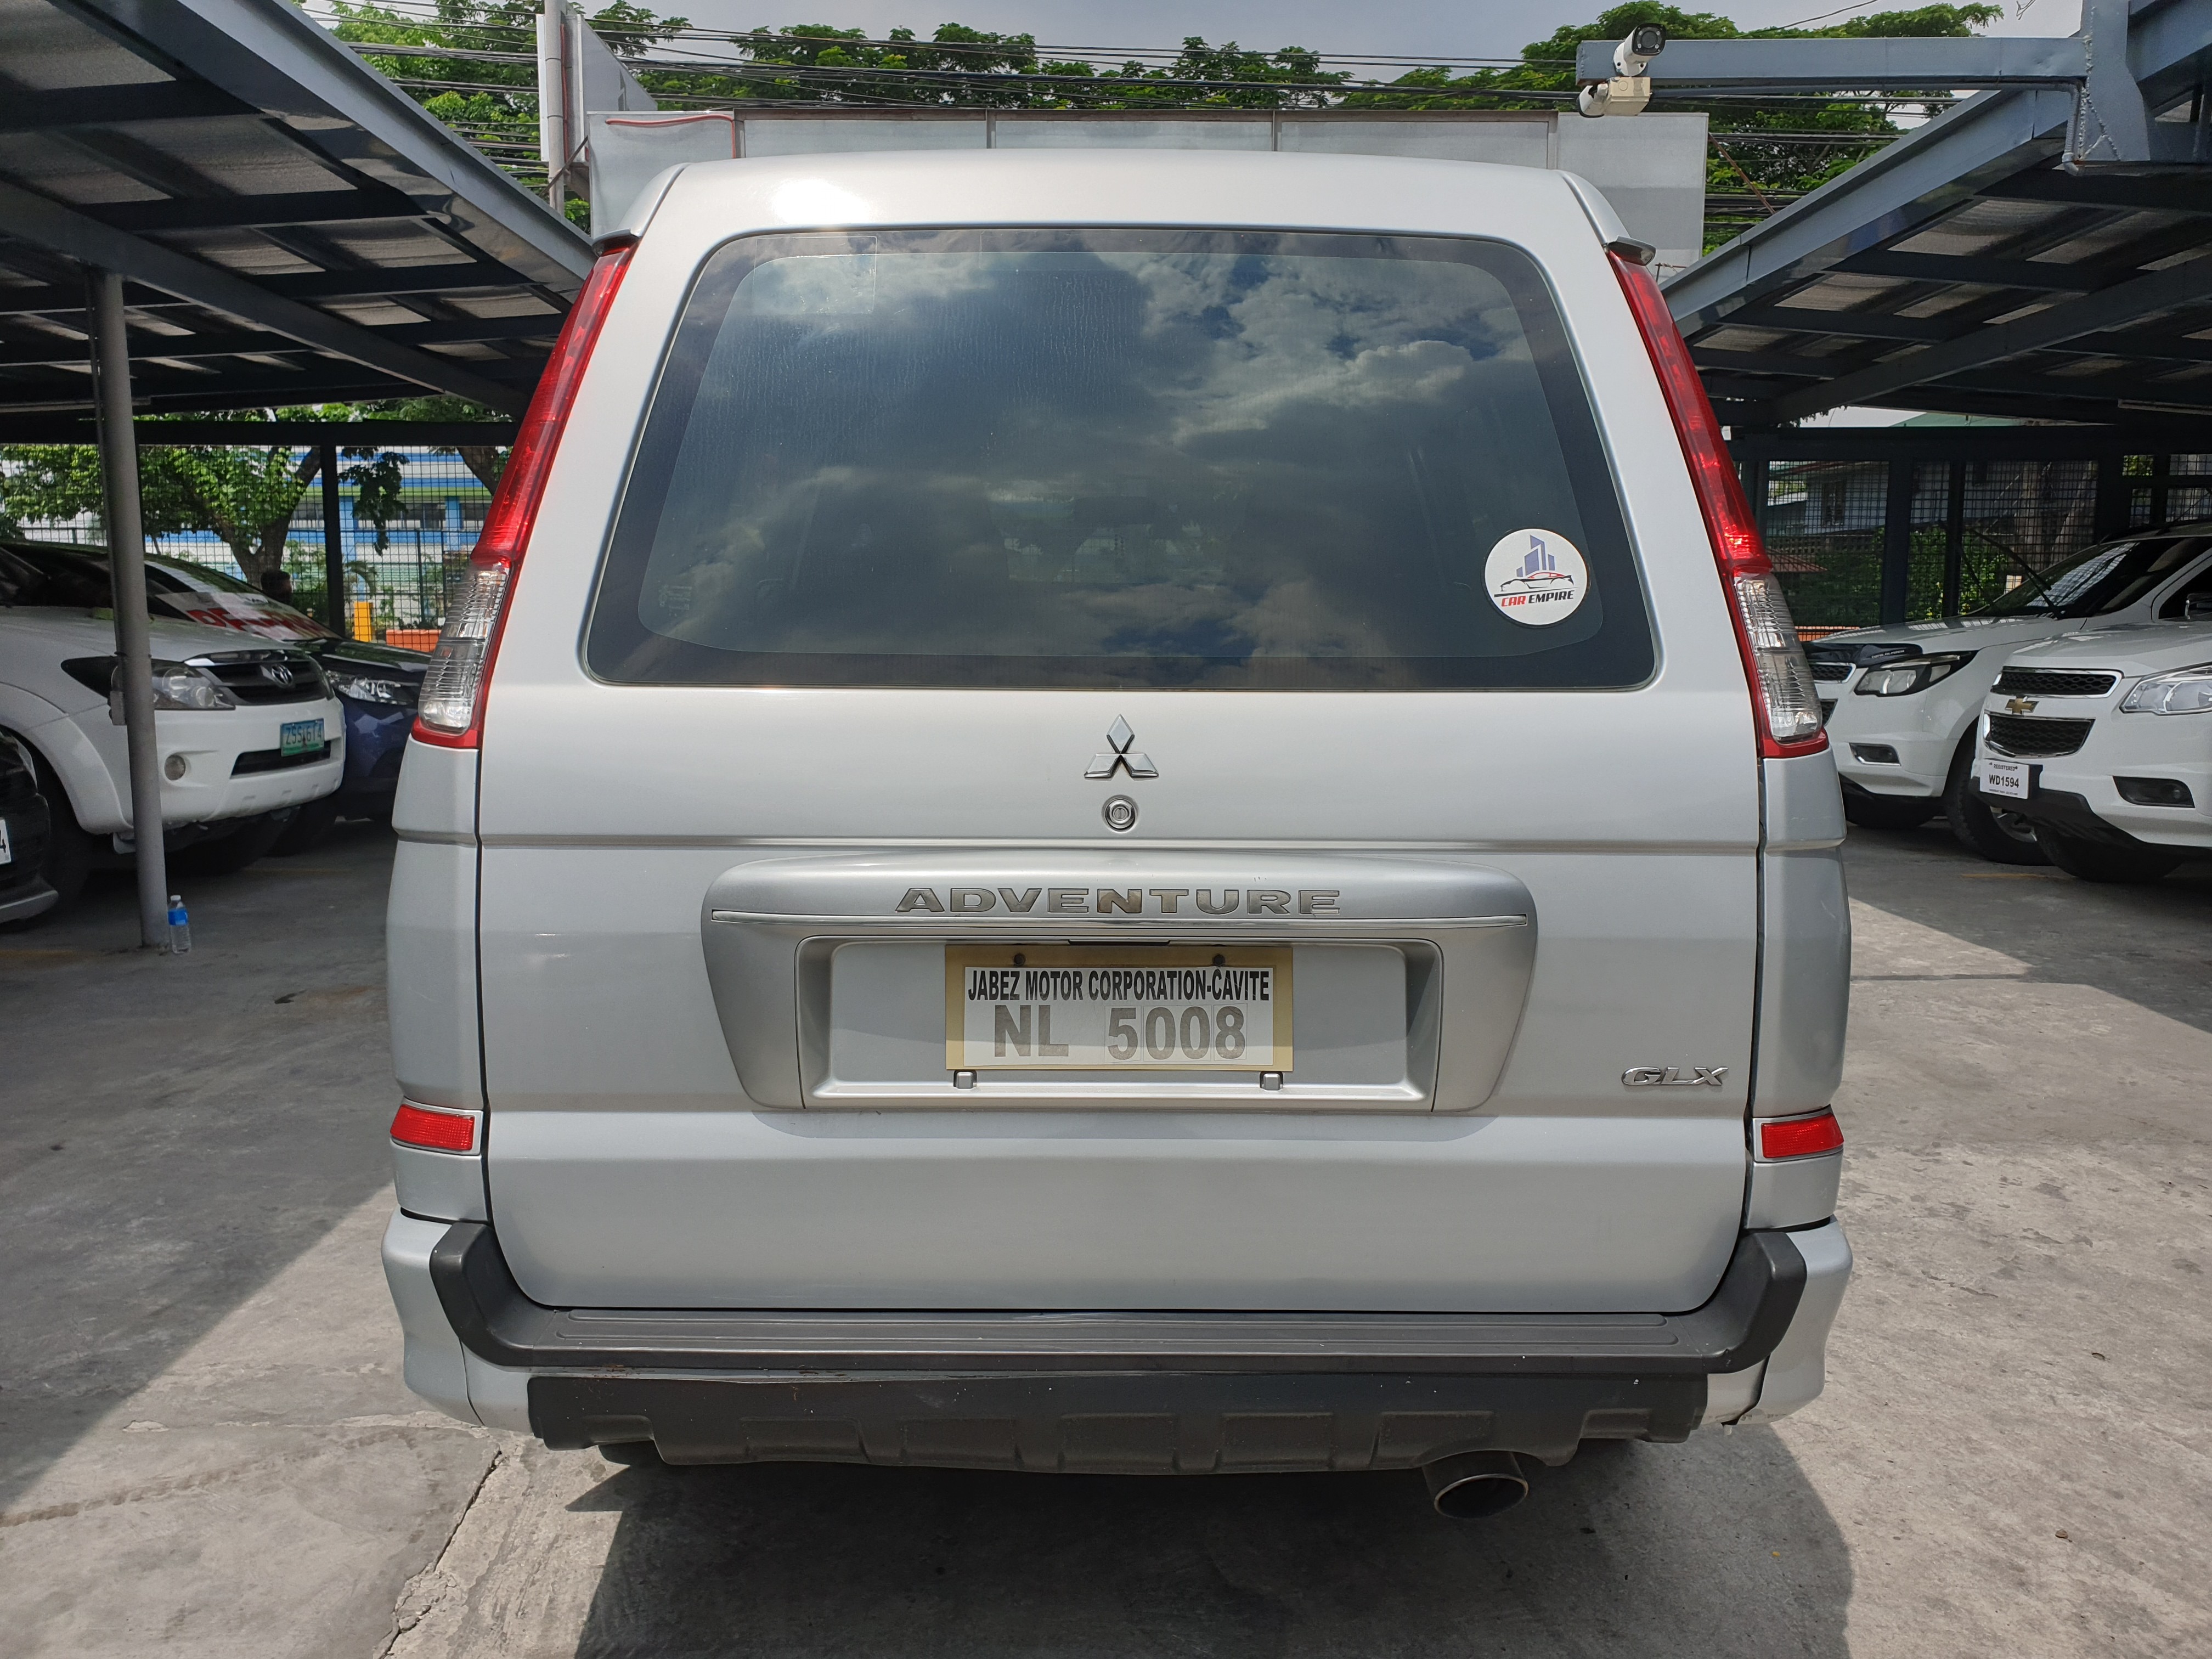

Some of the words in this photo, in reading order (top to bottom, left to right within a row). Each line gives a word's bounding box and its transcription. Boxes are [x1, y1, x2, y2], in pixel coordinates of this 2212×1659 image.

[1501, 596, 1526, 607] CAR
[1528, 590, 1575, 603] EMPIRE
[1989, 774, 2019, 788] WD1594
[895, 888, 1340, 914] ADVENTURE
[968, 970, 1020, 1001] JABEZ
[1025, 970, 1084, 1001] MOTOR
[994, 1005, 1069, 1057] NL
[1107, 1006, 1245, 1060] 5008
[1621, 1066, 1728, 1086] GLX
